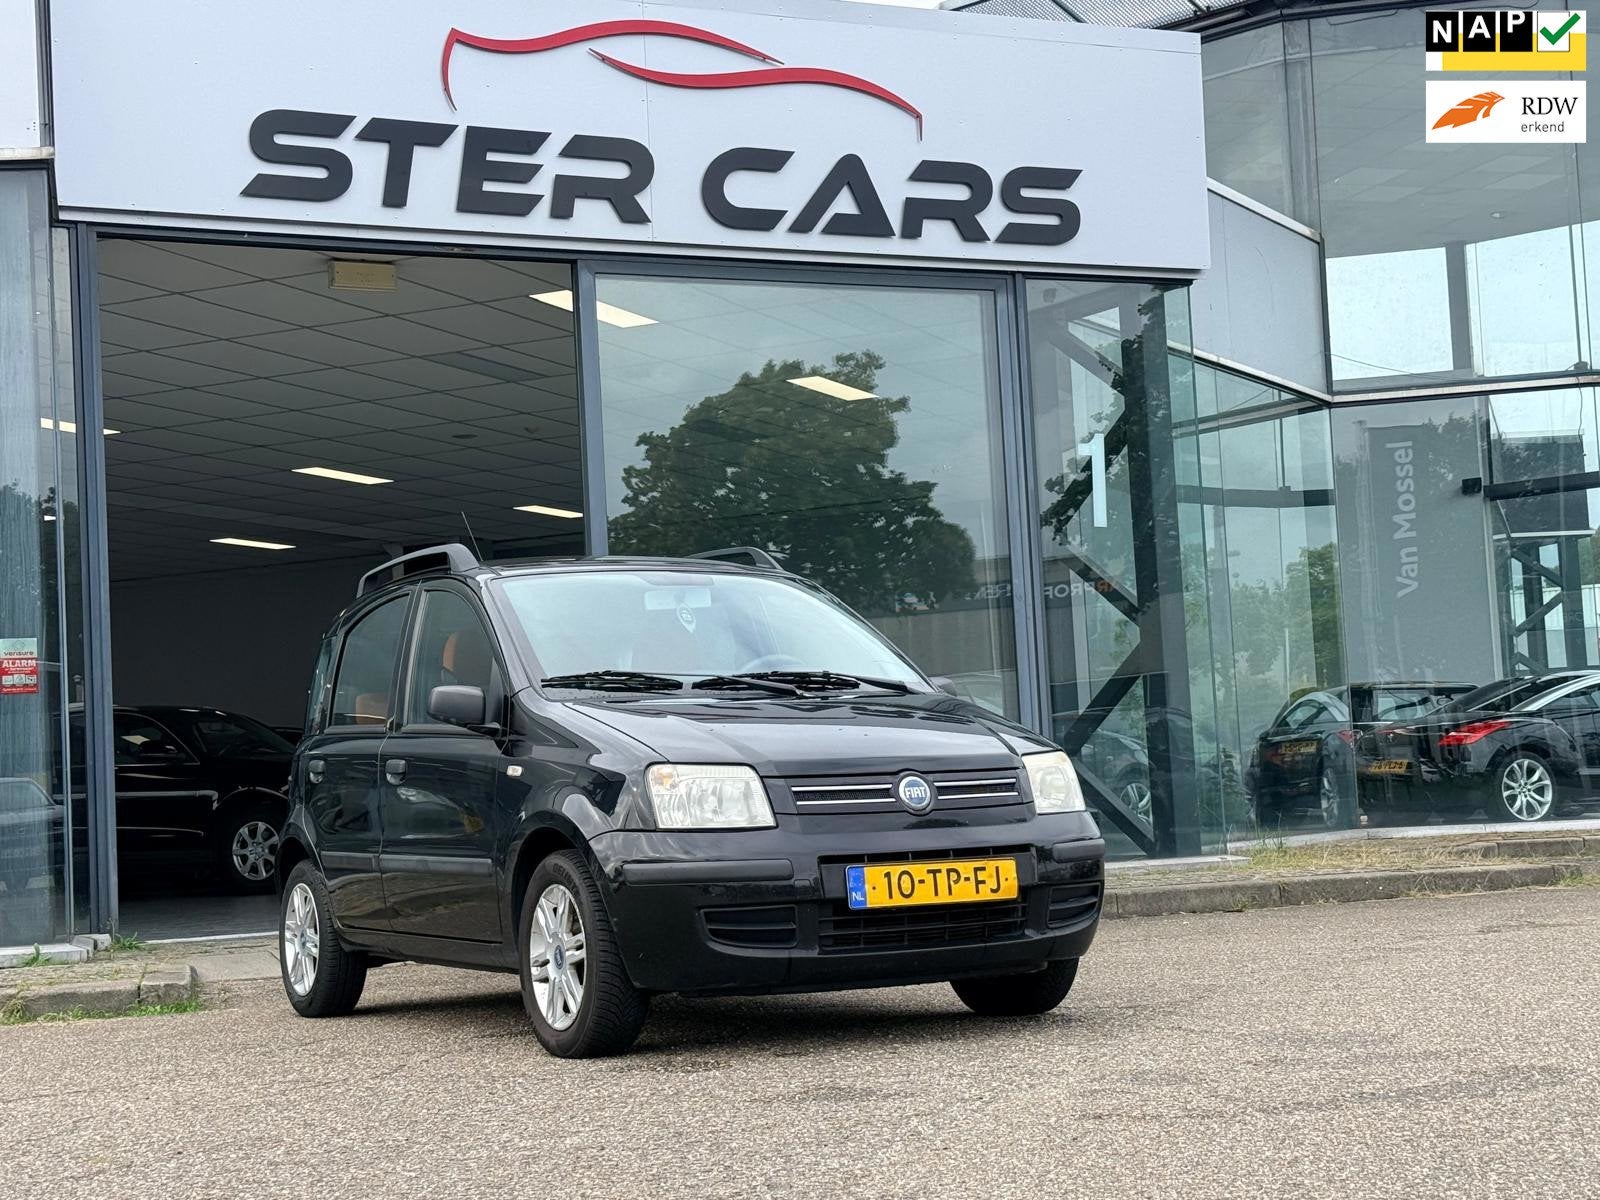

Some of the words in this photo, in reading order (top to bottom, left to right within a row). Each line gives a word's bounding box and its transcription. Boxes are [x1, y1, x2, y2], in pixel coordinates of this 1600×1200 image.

[240, 109, 655, 224] STER
[701, 147, 1083, 246] CARS
[1385, 440, 1417, 540] Mossel
[1396, 546, 1419, 598] Van
[2, 659, 36, 668] ALARM
[904, 786, 926, 798] FIAT
[852, 891, 865, 901] NL
[884, 865, 1001, 899] 10-TP-FJ
